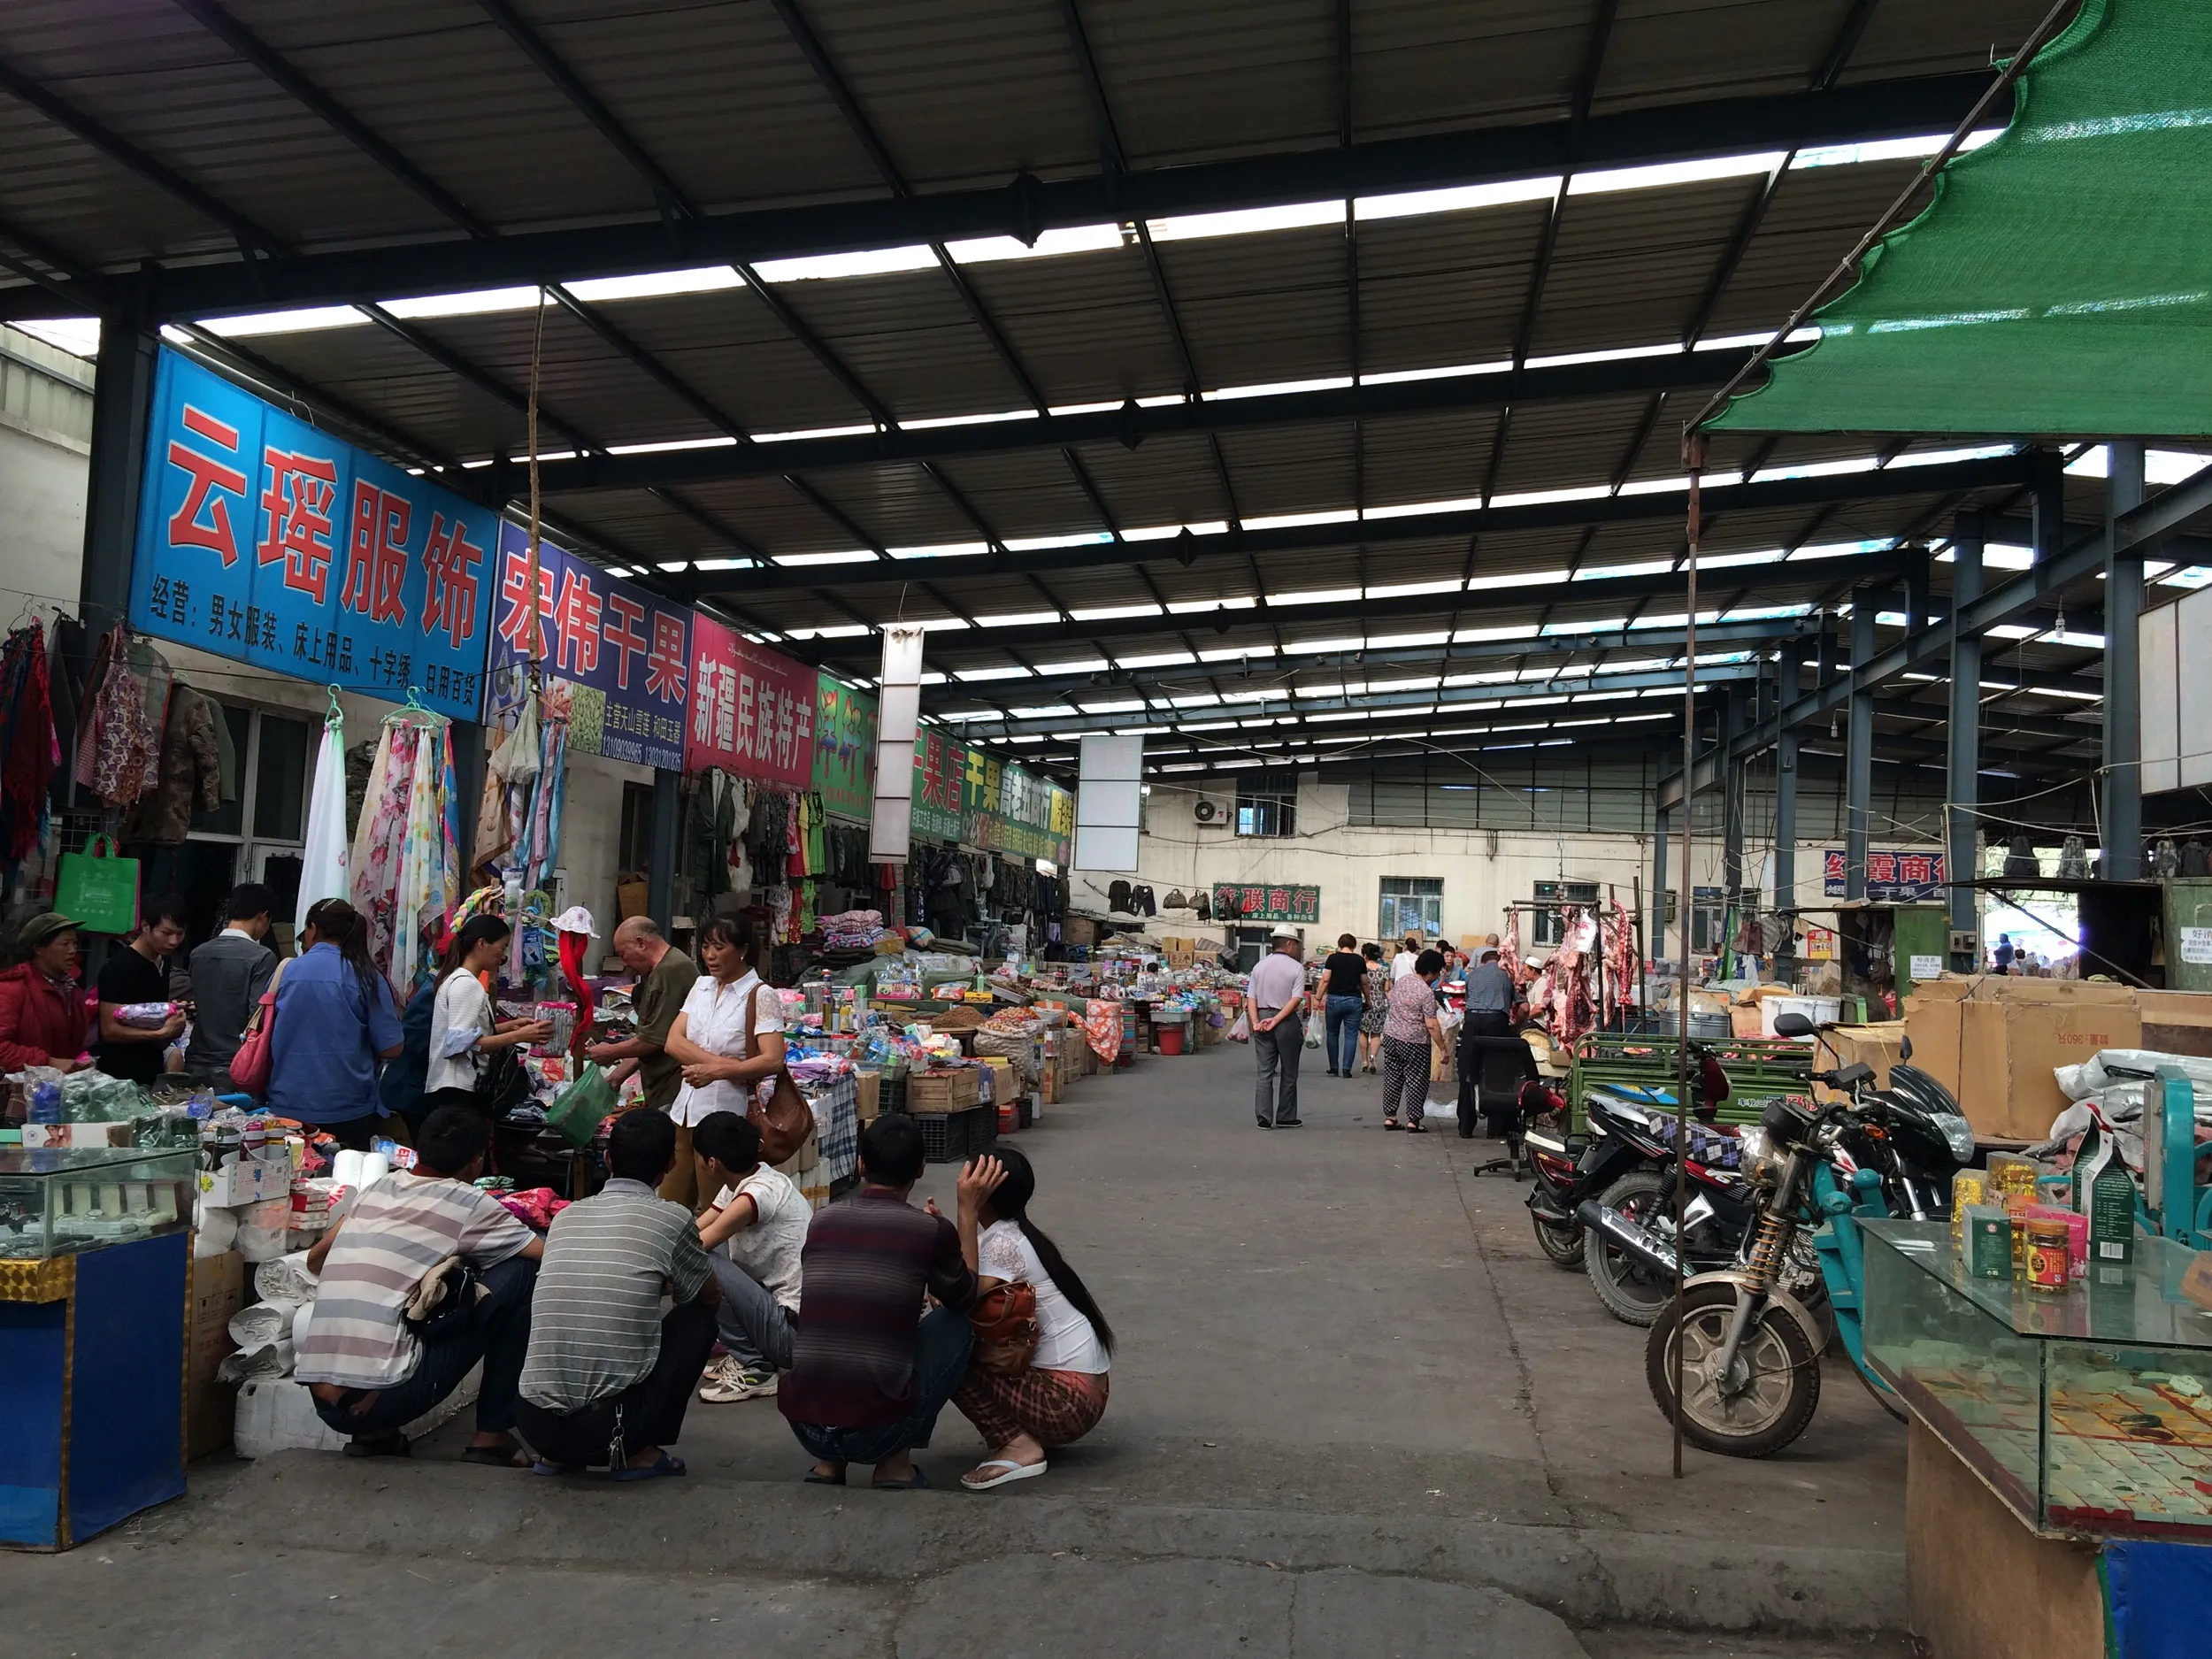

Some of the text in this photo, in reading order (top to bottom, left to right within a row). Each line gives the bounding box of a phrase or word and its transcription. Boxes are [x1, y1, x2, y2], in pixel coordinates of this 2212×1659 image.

[167, 402, 484, 650] 云瑶服饰
[498, 549, 687, 704] 宏伟干果
[694, 652, 811, 772] 新疆民族特产
[965, 750, 1001, 812] 干果
